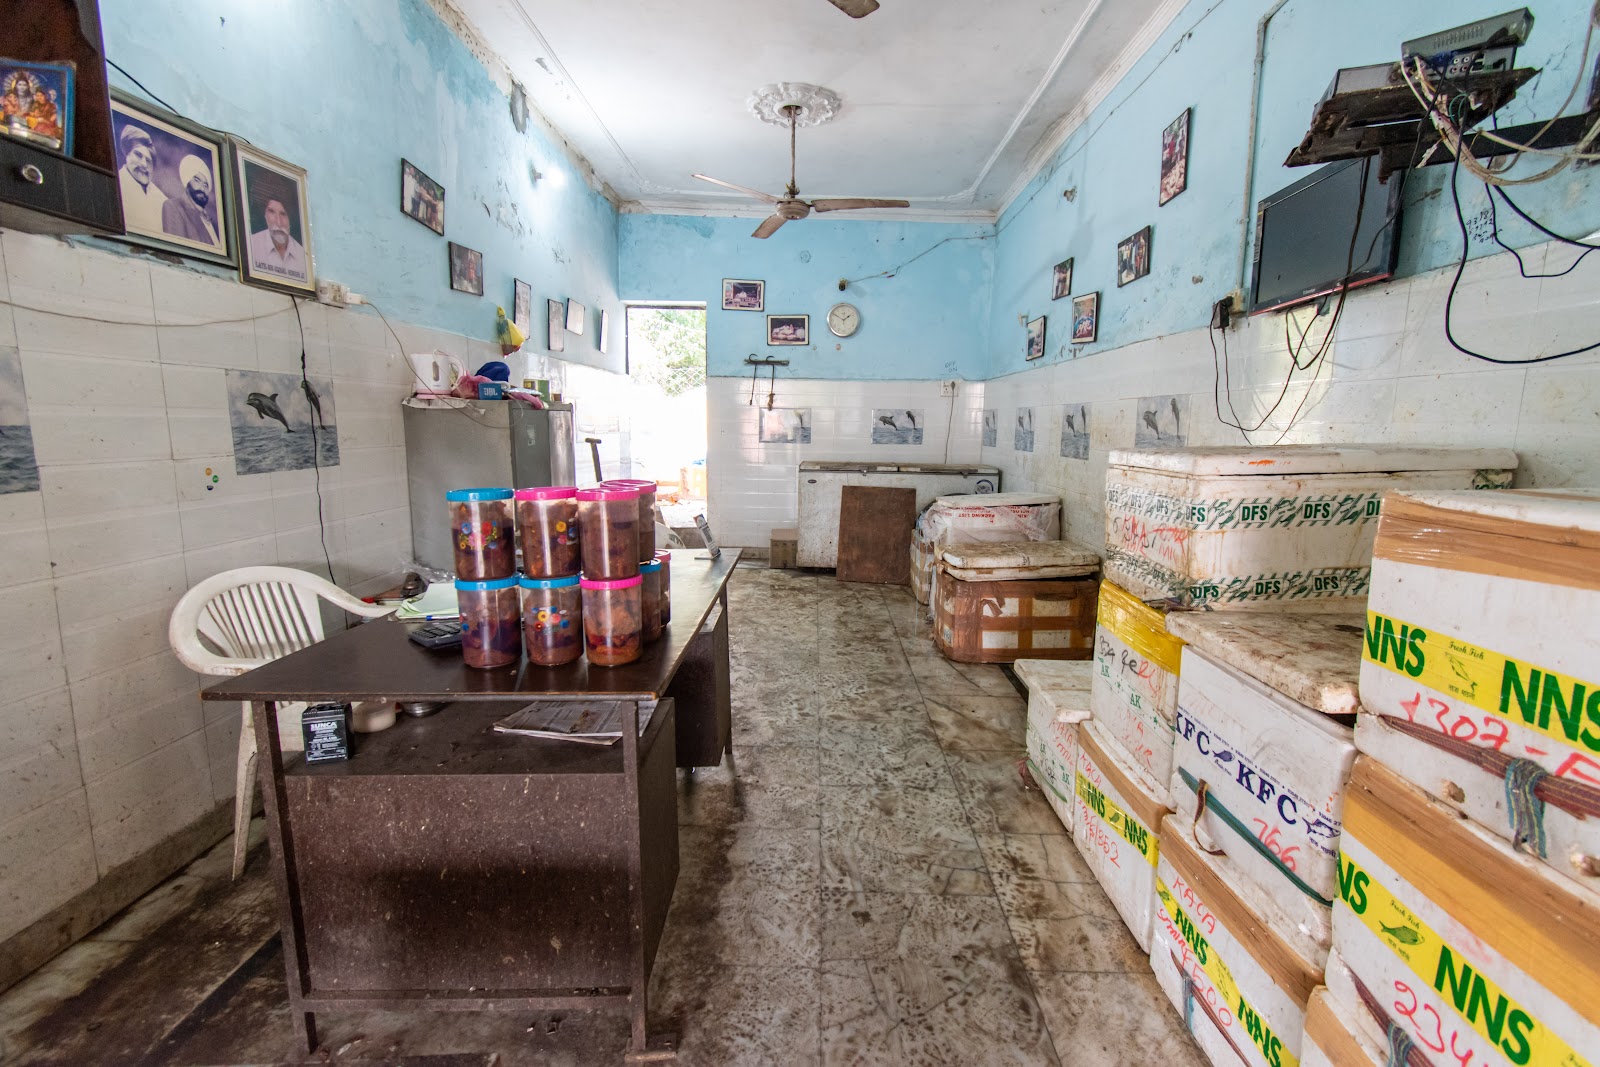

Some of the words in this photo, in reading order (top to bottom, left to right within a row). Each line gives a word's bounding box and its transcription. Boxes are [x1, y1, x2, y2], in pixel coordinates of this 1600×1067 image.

[483, 387, 498, 396] JBL
[1185, 506, 1206, 523] DFS
[1241, 505, 1268, 521] DFS
[1303, 502, 1331, 519] DFS
[1254, 580, 1282, 596] DFS
[1314, 576, 1339, 591] DFS
[1448, 641, 1467, 654] Fresh
[1469, 648, 1484, 660] Fish
[1129, 692, 1142, 709] AK
[1235, 760, 1297, 825] KFC
[1087, 782, 1106, 818] NNS
[1124, 813, 1148, 856] NNS
[1337, 851, 1370, 915] NS
[1434, 944, 1535, 1067] NNS
[1174, 907, 1209, 966] NNS
[1237, 994, 1282, 1067] NNS
